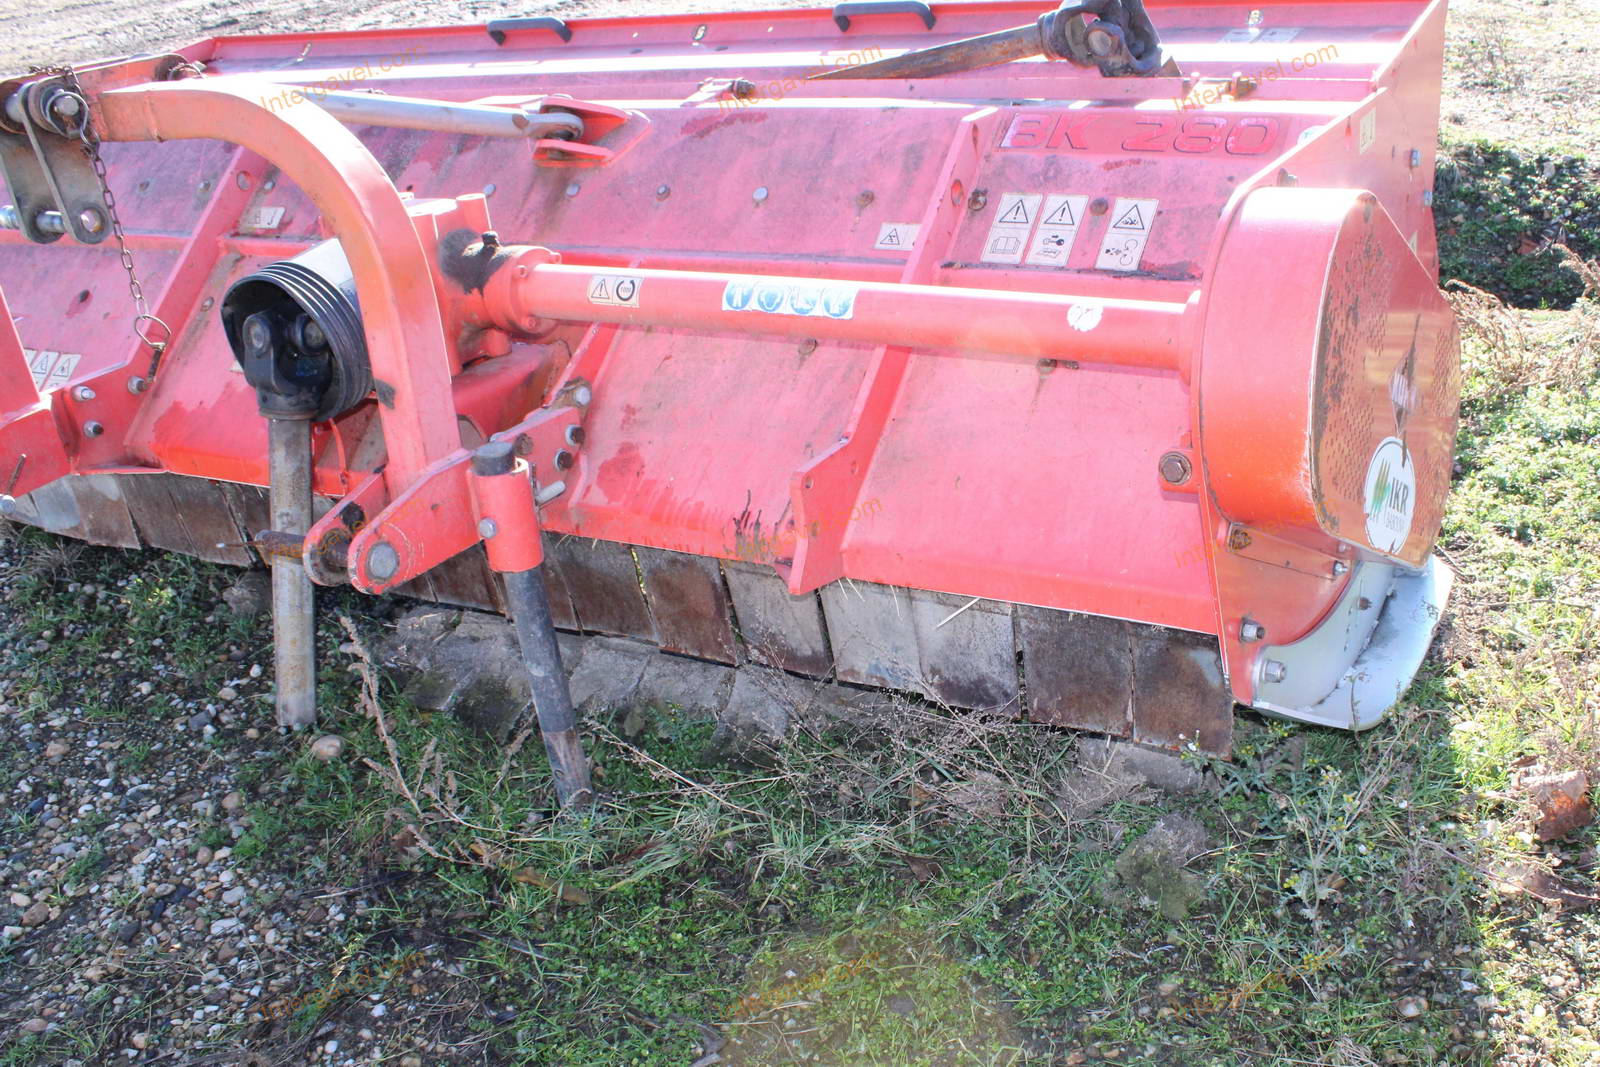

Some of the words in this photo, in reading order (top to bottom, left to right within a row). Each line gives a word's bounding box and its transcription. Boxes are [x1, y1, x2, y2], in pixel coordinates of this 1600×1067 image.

[1000, 112, 1097, 150] BK
[1121, 114, 1281, 155] 280
[1388, 476, 1410, 516] IKR
